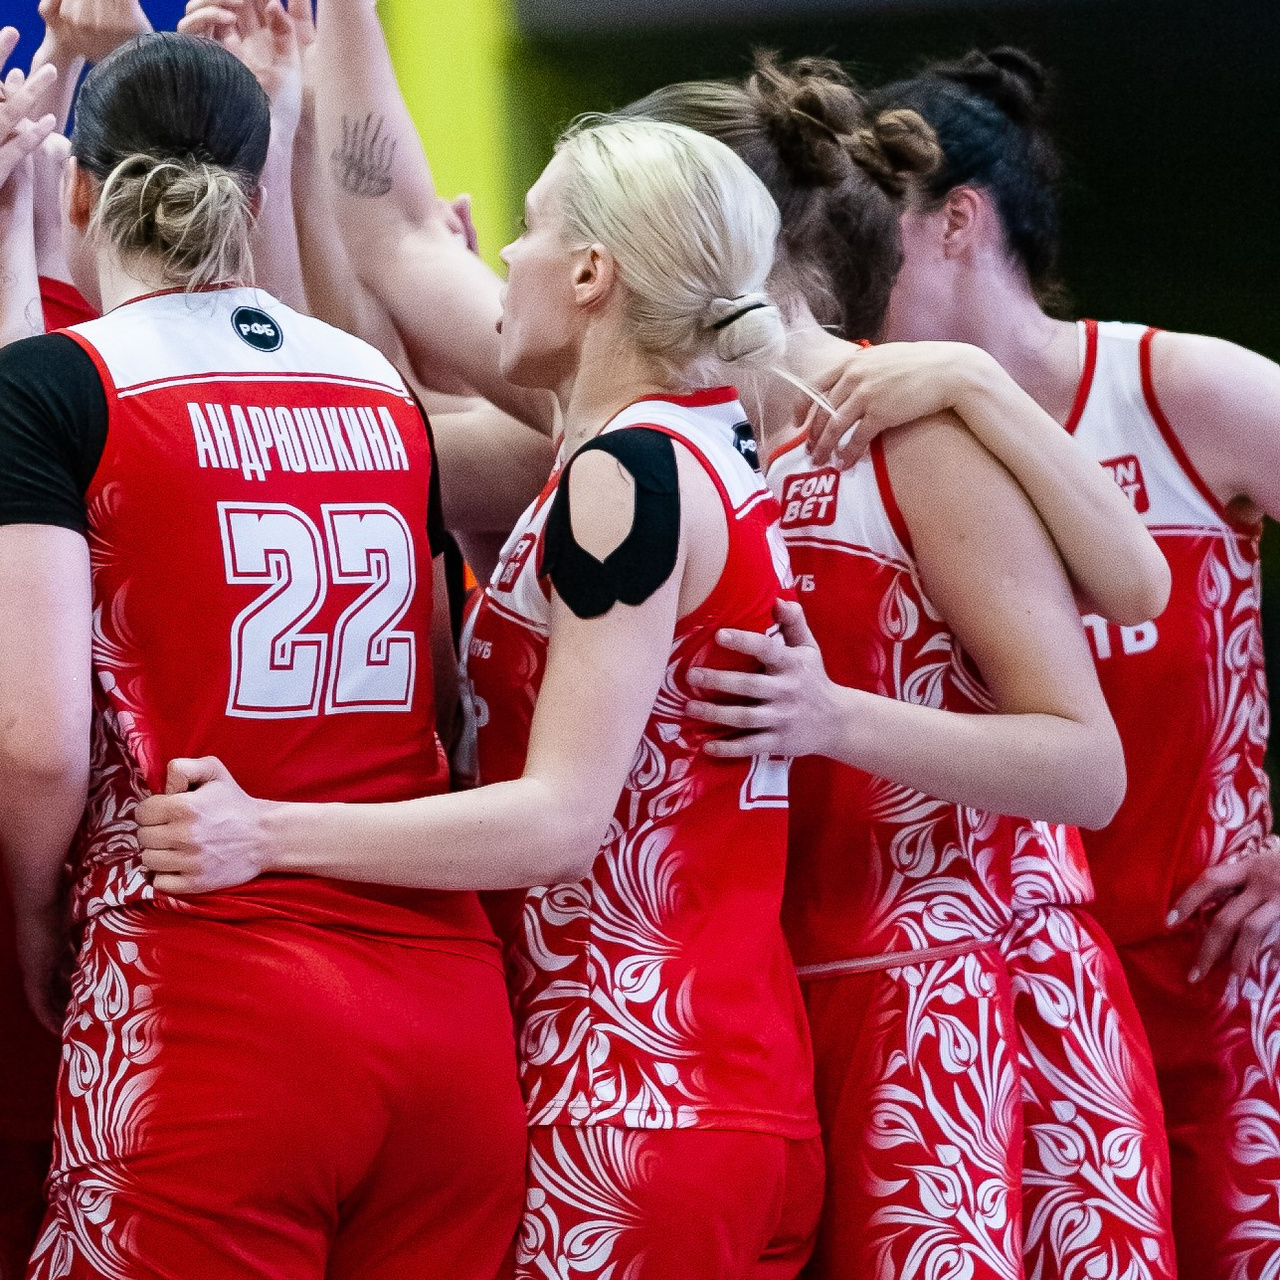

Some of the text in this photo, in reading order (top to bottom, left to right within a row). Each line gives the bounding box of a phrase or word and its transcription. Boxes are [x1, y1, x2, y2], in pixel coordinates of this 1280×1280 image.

[238, 322, 276, 337] РФБ
[186, 401, 410, 482] АНДРЮШКИНА
[786, 474, 835, 500] FON
[782, 495, 834, 523] BET
[216, 500, 417, 720] 22
